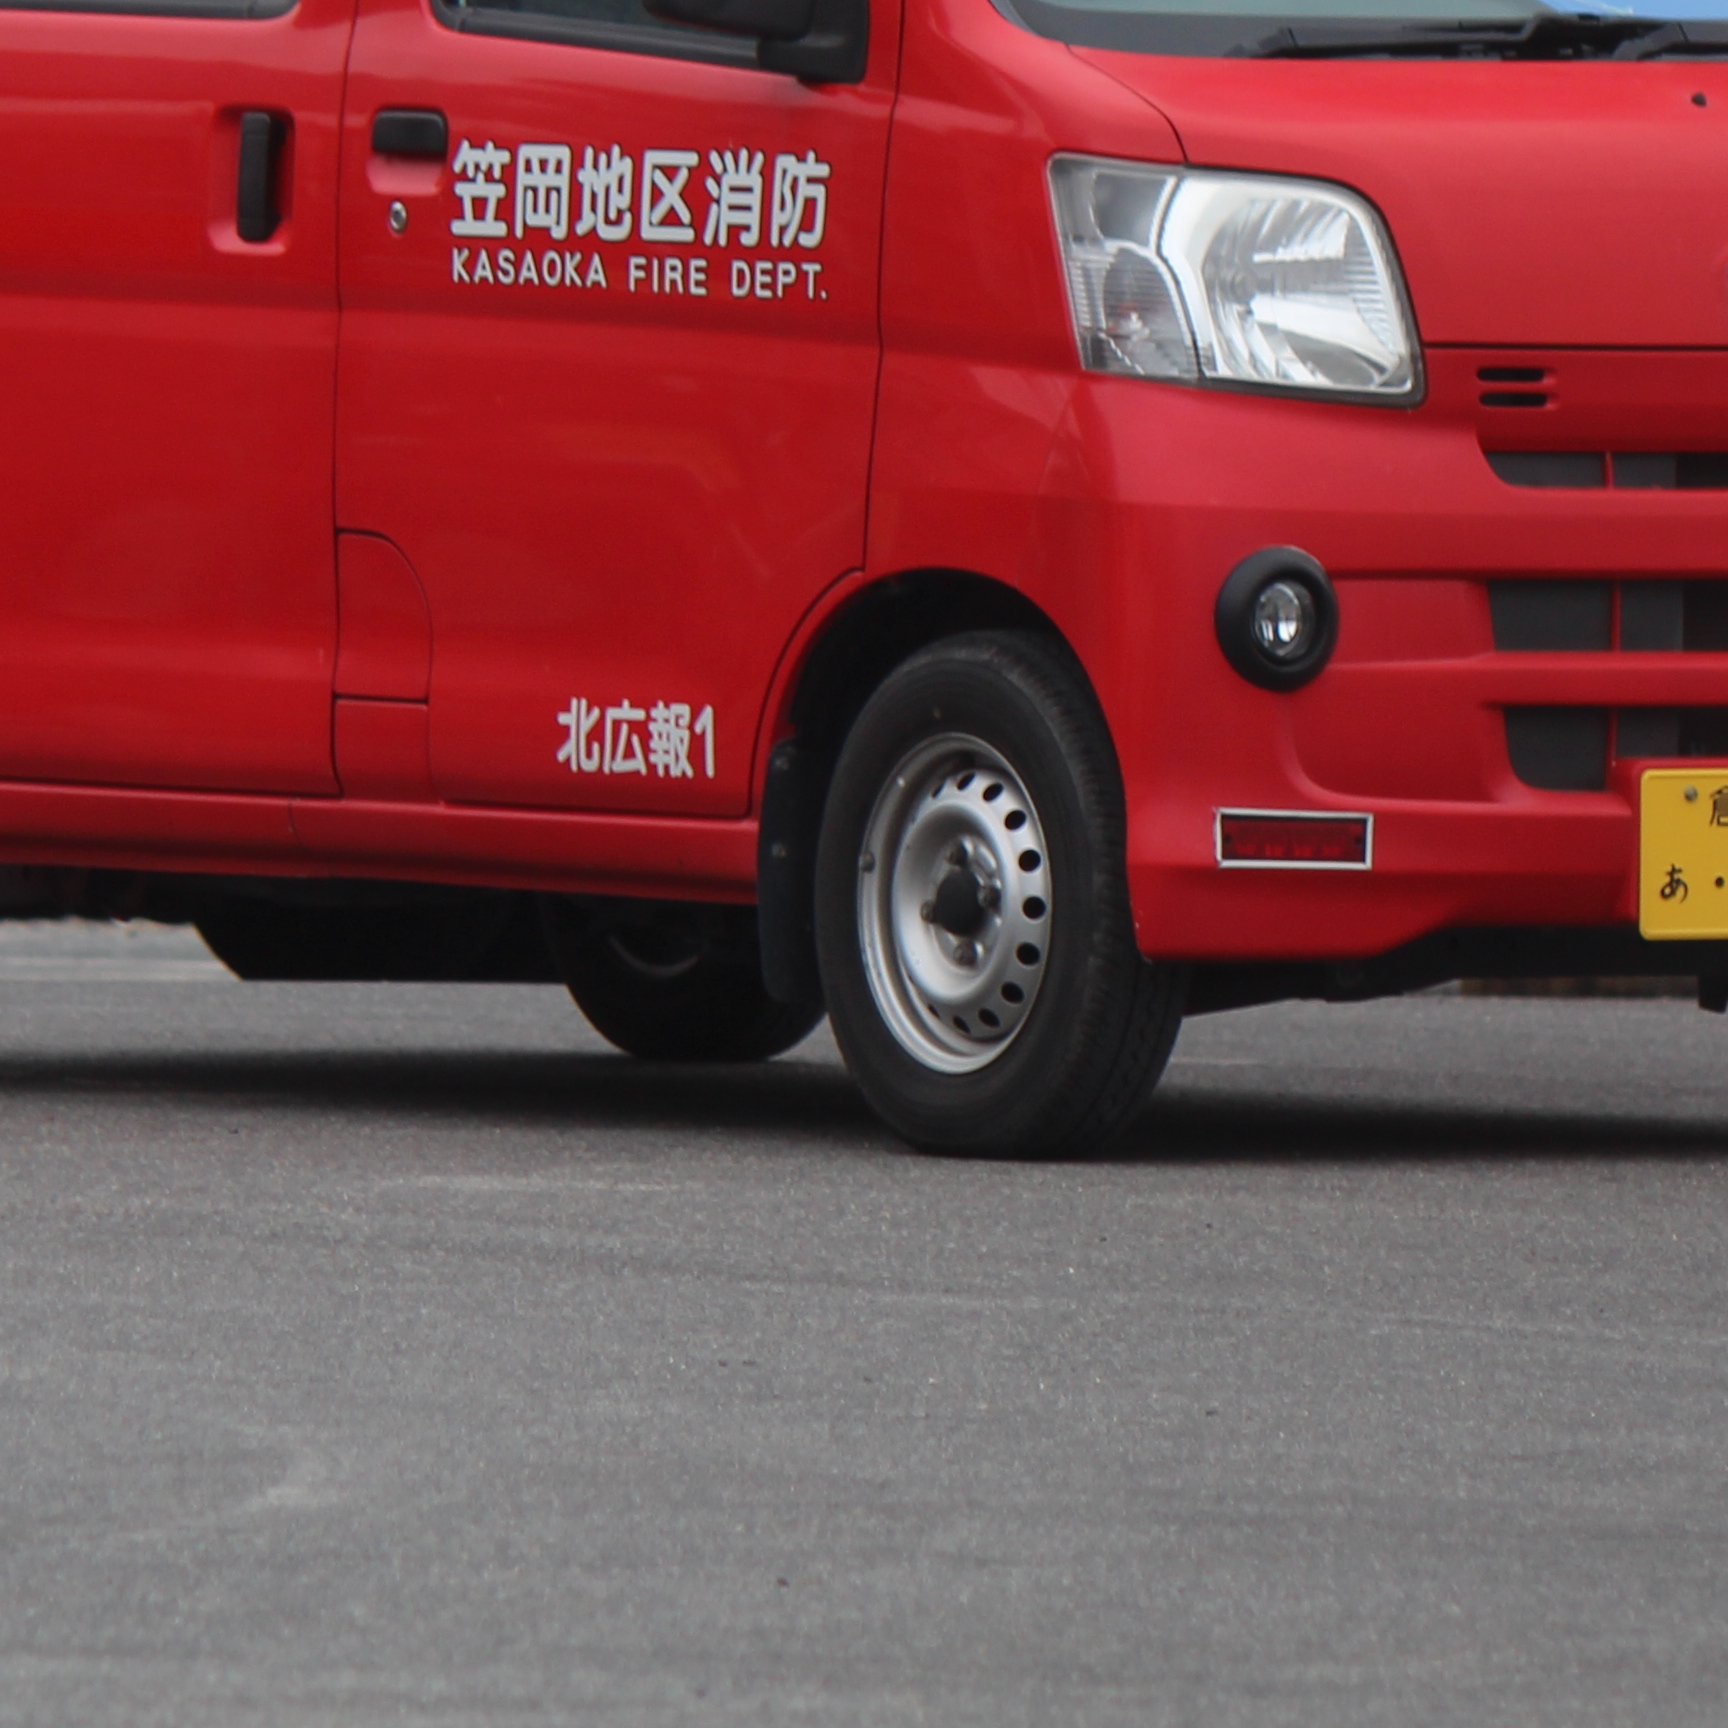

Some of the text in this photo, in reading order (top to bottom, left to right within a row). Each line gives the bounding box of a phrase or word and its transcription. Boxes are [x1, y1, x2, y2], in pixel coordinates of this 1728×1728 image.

[450, 138, 832, 250] 笠岡地区消防
[450, 247, 830, 301] KASAOKA FIRE DEPT.
[556, 695, 716, 779] 北広報1
[1659, 863, 1689, 904] あ
